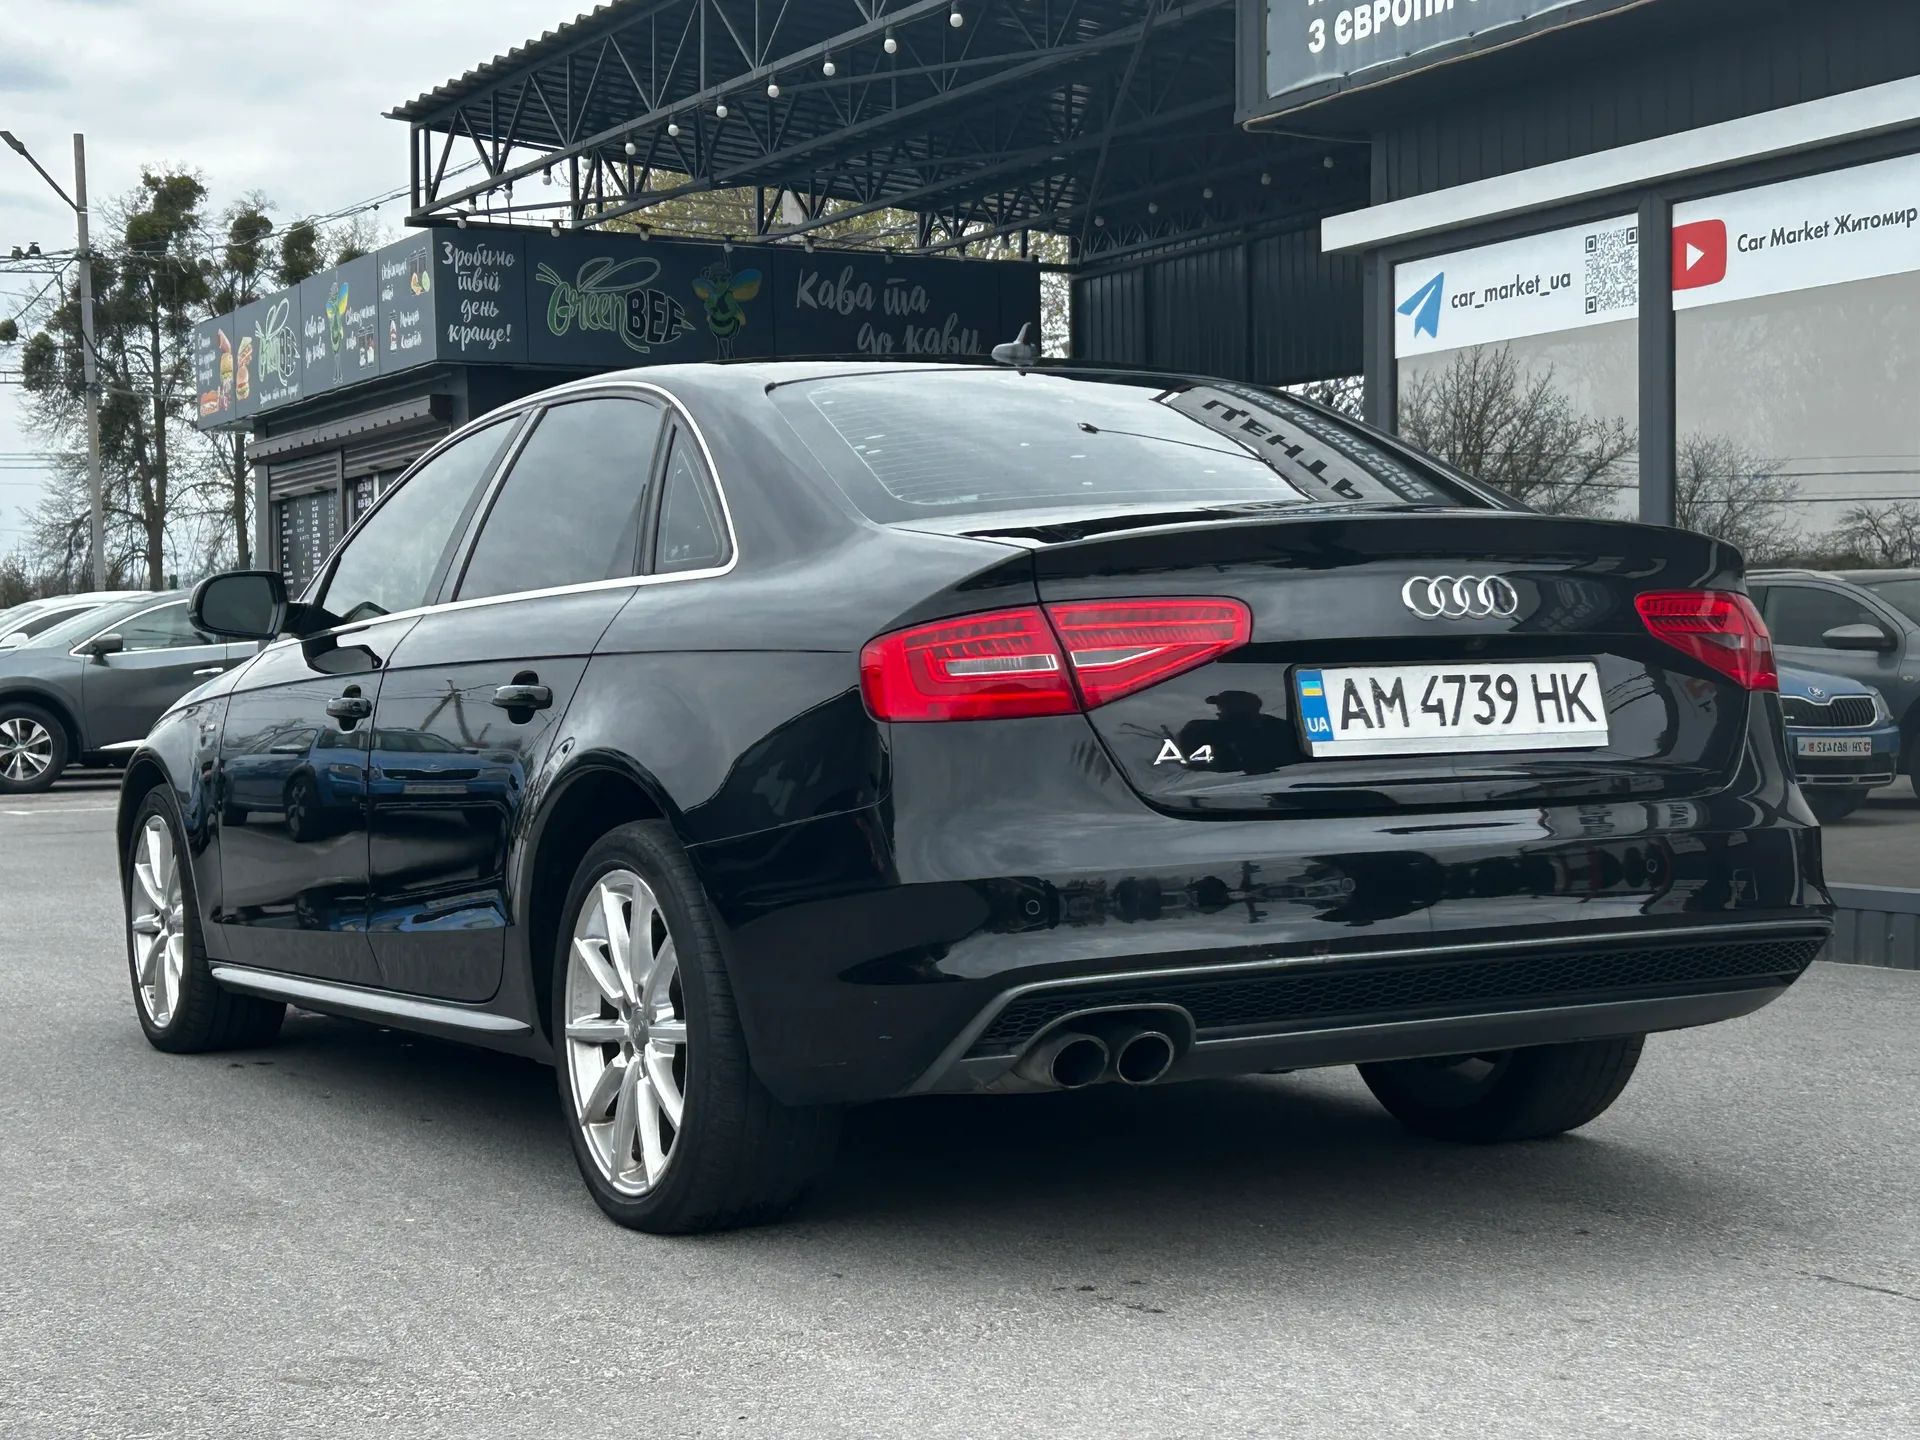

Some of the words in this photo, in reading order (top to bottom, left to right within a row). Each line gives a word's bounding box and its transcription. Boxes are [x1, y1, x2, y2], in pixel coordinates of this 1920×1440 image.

[1737, 233, 1767, 253] Car
[1769, 220, 1830, 248] Market
[1833, 207, 1918, 236] Житомир
[796, 265, 877, 316] Кава
[883, 277, 931, 317] та
[1451, 272, 1571, 309] car_market_ua
[460, 299, 500, 324] день
[448, 323, 512, 352] краще!
[902, 312, 982, 355] кави
[1306, 716, 1330, 733] UA
[1339, 676, 1410, 731] AM
[1420, 673, 1518, 727] 4739
[1531, 672, 1597, 724] HK
[1153, 738, 1215, 766] A4
